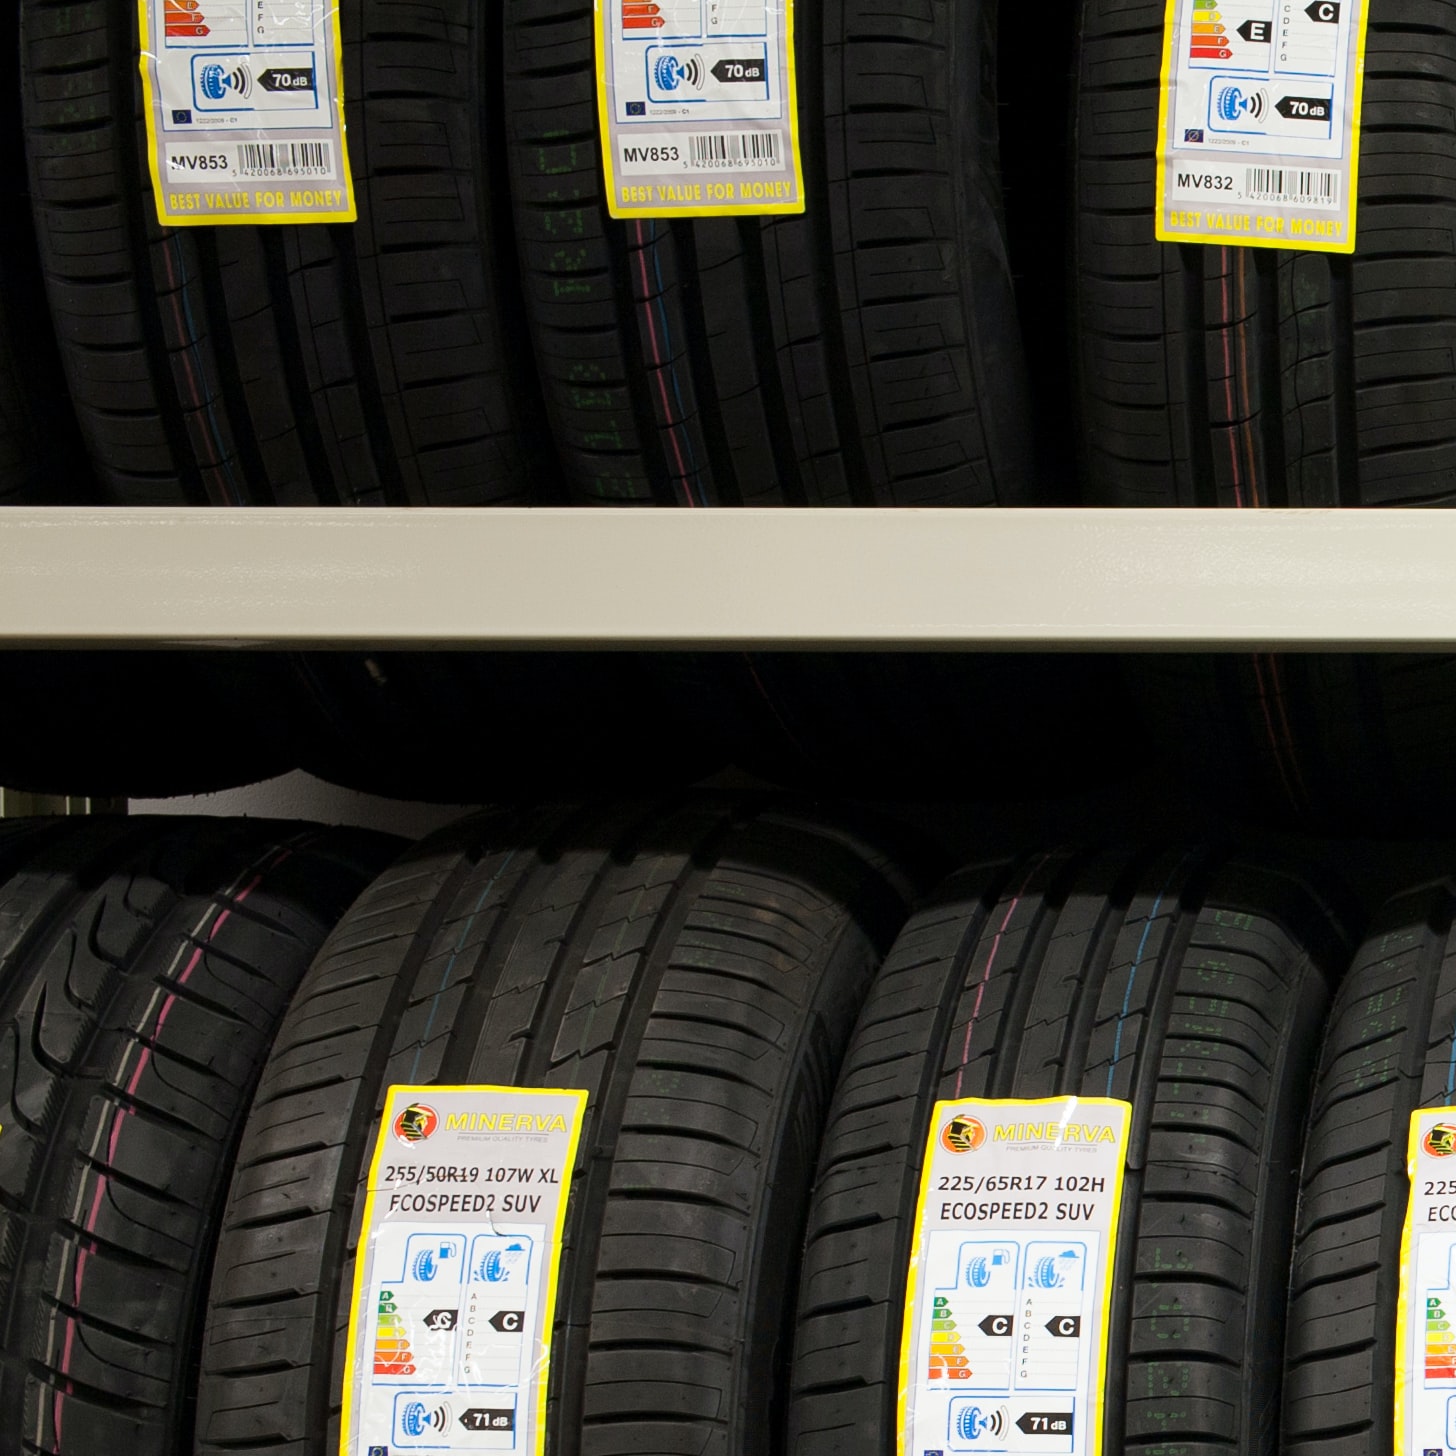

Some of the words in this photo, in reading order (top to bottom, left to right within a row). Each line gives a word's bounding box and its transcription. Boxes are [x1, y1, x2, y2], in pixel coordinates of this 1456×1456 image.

[1318, 4, 1334, 20] C
[1250, 22, 1265, 40] E
[171, 155, 228, 170] MV853
[624, 147, 679, 162] MV853
[1177, 173, 1233, 190] MV832
[169, 193, 200, 210] BEST
[207, 192, 250, 209] VALUE
[255, 192, 285, 207] FOR
[290, 190, 342, 207] MONEY
[621, 186, 653, 203] BEST
[657, 185, 701, 201] VALUE
[706, 183, 735, 199] FOR
[740, 181, 792, 199] MONEY
[1170, 211, 1201, 227] BEST
[1207, 213, 1250, 232] VALUE
[1256, 216, 1284, 233] FOR
[1290, 219, 1343, 237] MONEY
[444, 1112, 567, 1133] MINERVA
[993, 1122, 1116, 1143] MINERVA
[384, 1165, 479, 1186] 255/50R19
[484, 1168, 534, 1183] 107W
[538, 1168, 559, 1184] XL
[938, 1175, 1047, 1195] 225/65R17
[1054, 1176, 1105, 1193] 102H
[502, 1194, 542, 1214] SUV
[940, 1202, 1049, 1221] ECOSPEED2
[1056, 1203, 1095, 1221] SUV
[502, 1313, 518, 1330] C
[992, 1317, 1007, 1334] C
[1058, 1318, 1074, 1335] C
